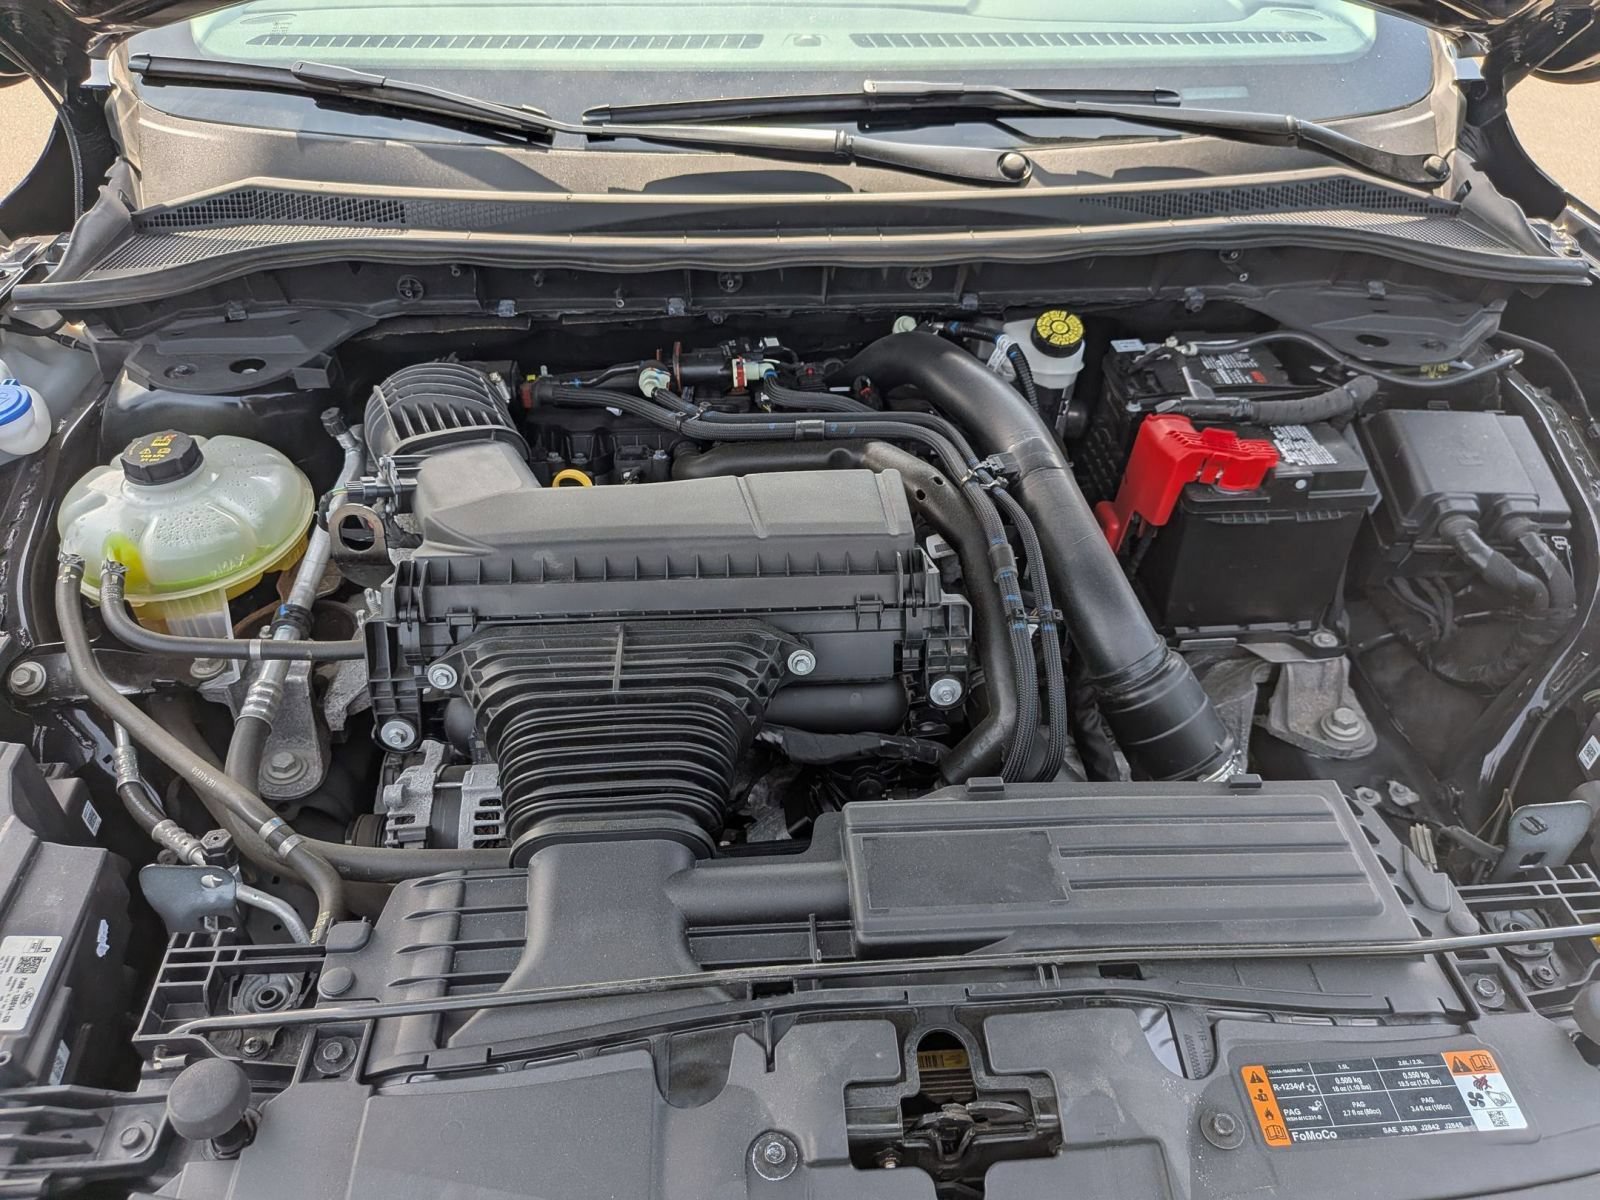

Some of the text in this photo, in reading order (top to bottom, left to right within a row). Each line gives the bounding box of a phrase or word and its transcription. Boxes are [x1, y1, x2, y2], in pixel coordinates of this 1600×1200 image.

[1403, 1070, 1430, 1079] 0.550 kg
[1353, 1076, 1363, 1084] kg
[1273, 1082, 1306, 1092] R-1234yf
[1364, 1108, 1382, 1116] (80cc)
[1432, 1103, 1453, 1112] (100cc)
[1283, 1108, 1302, 1117] PAG
[1401, 1125, 1417, 1133] J639
[1292, 1130, 1338, 1142] FoMoCo
